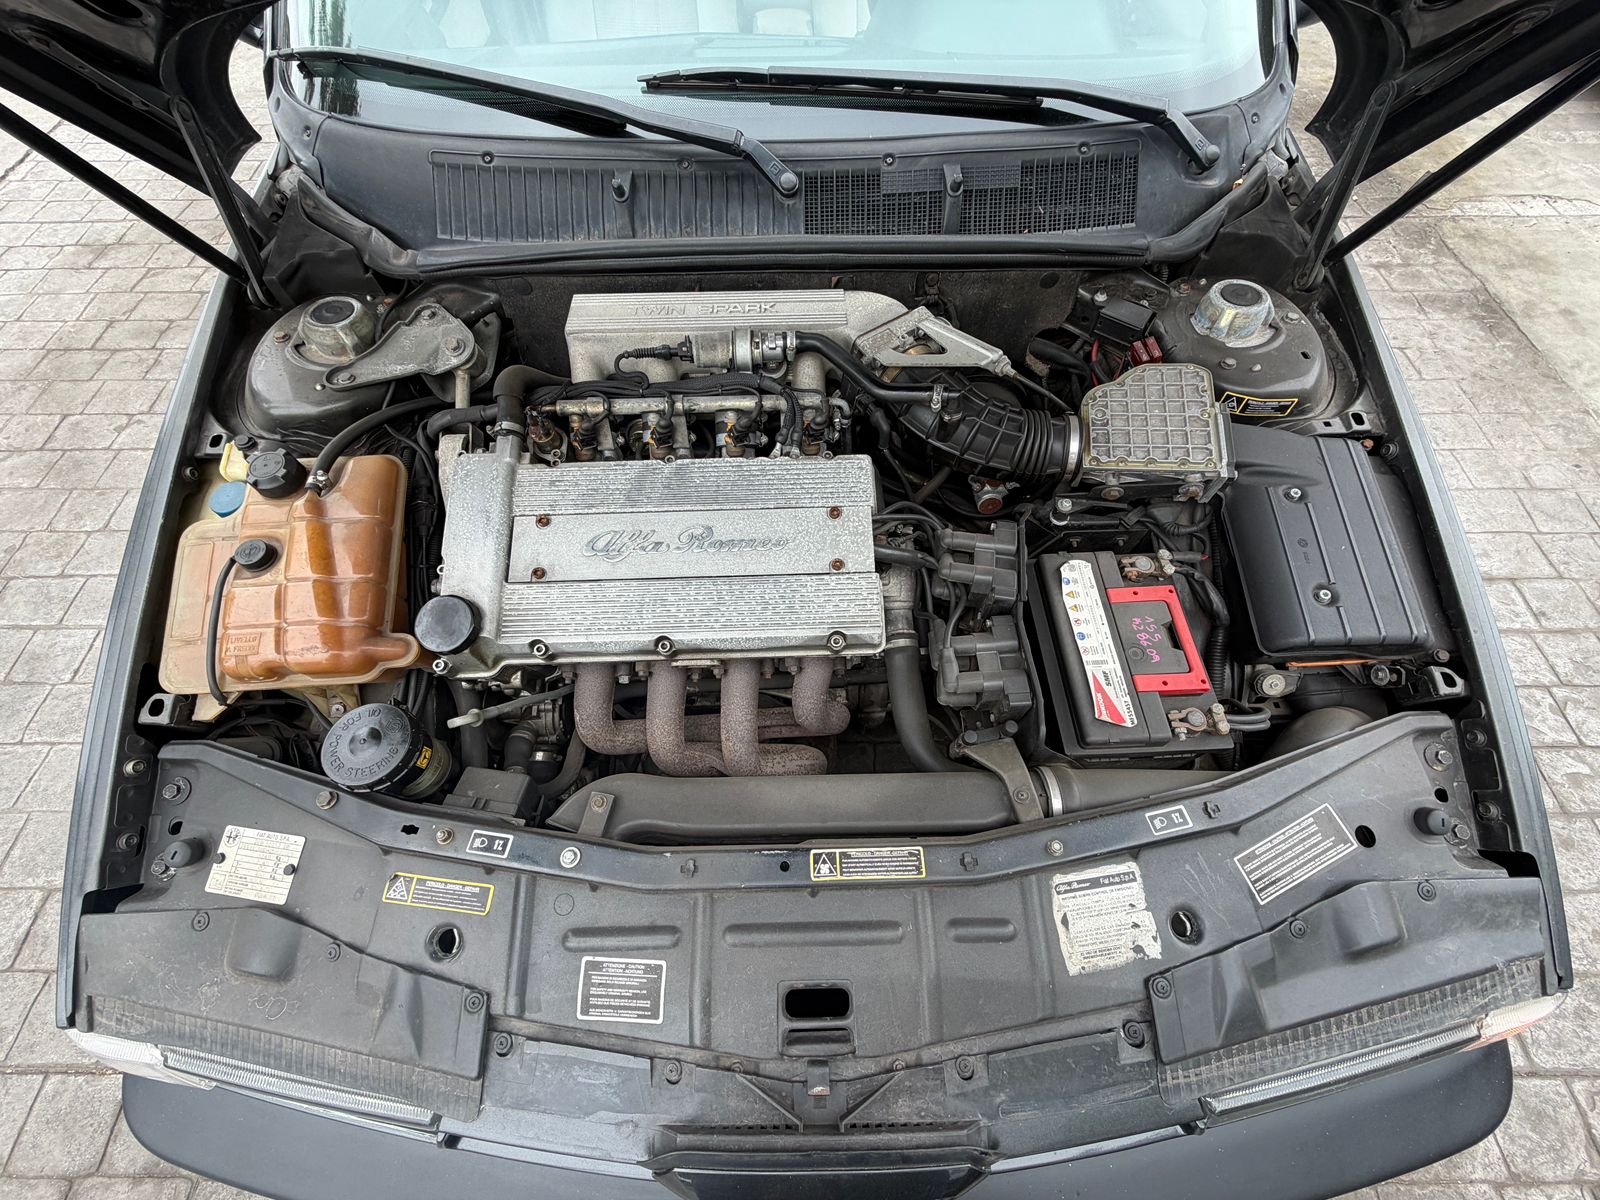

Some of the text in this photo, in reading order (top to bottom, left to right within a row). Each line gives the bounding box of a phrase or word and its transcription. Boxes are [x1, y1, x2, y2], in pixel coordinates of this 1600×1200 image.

[628, 302, 779, 316] TWIN SPARK
[583, 525, 789, 562] Alfa Romeo
[1102, 670, 1112, 687] SMF
[329, 708, 399, 778] OIL FOR POWER STEERING
